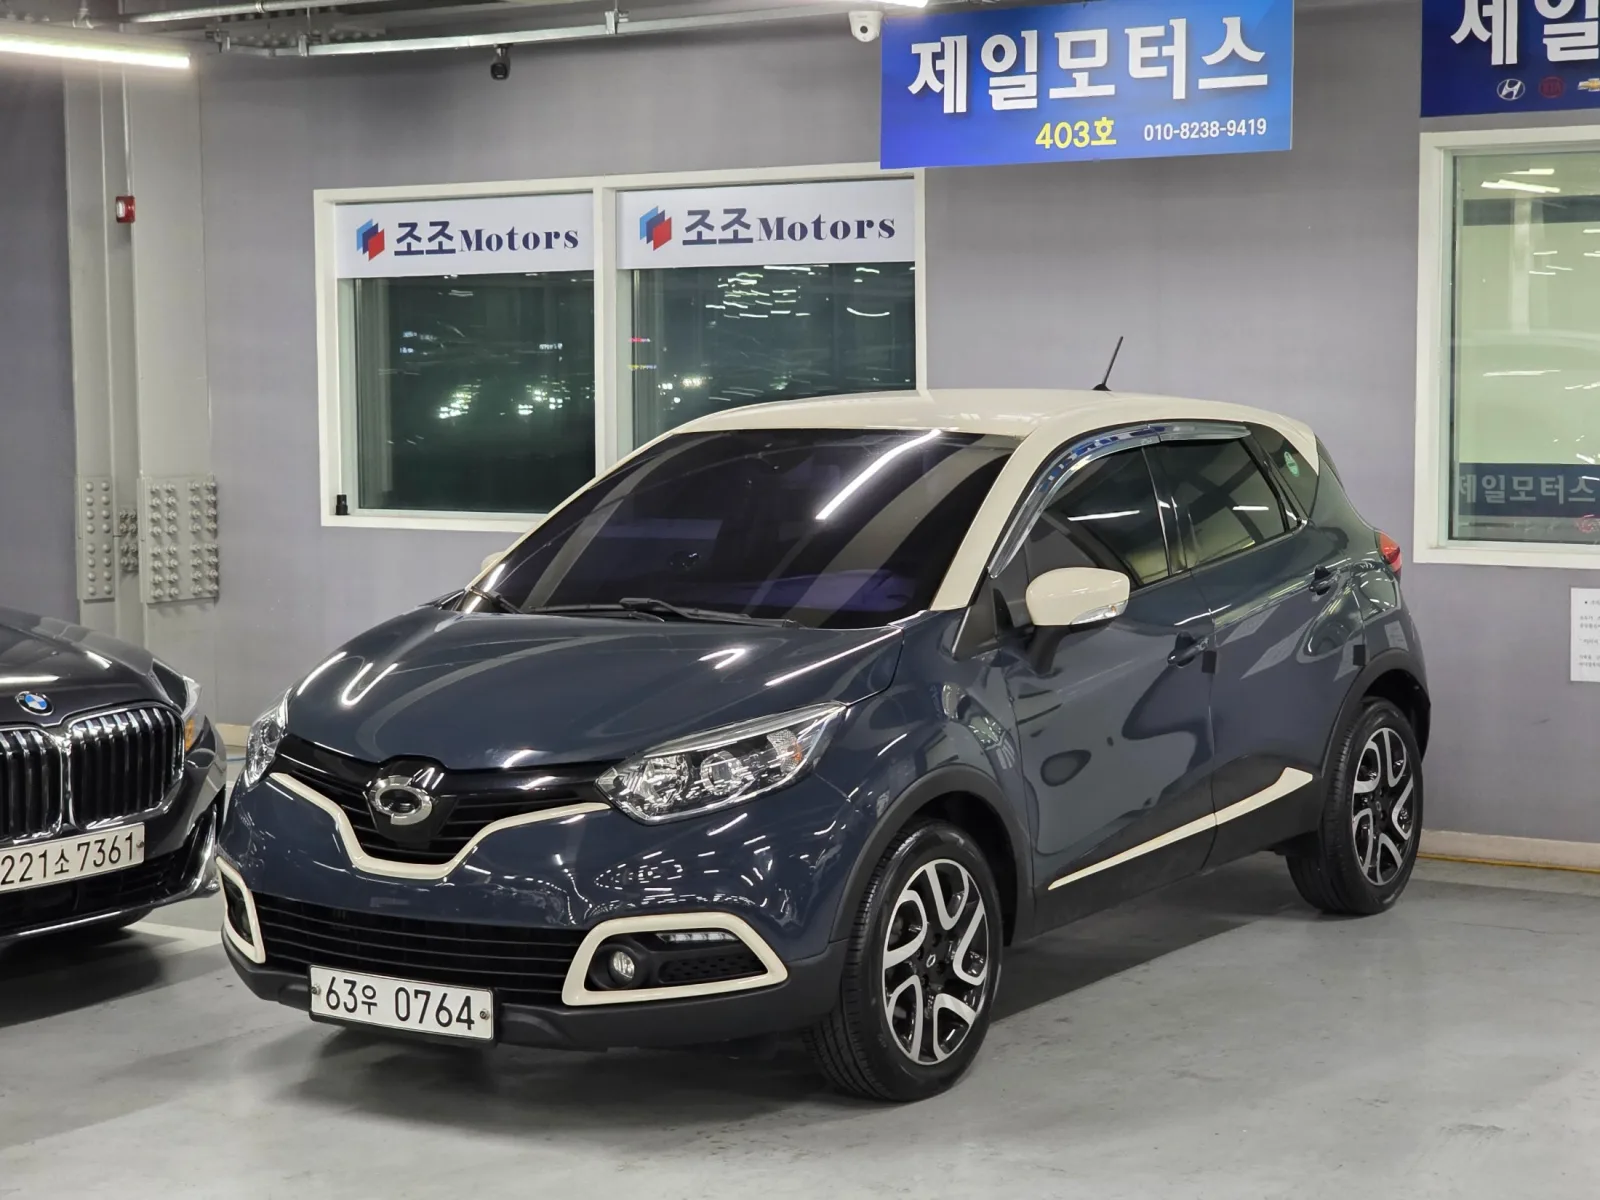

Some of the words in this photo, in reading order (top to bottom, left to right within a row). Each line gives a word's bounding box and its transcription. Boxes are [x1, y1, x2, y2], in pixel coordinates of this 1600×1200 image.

[907, 16, 1268, 114] 제일모터스
[1035, 116, 1117, 149] 403호
[1143, 117, 1268, 142] 010-8238-9419
[326, 976, 378, 1015] 63우
[394, 986, 475, 1031] 0764
